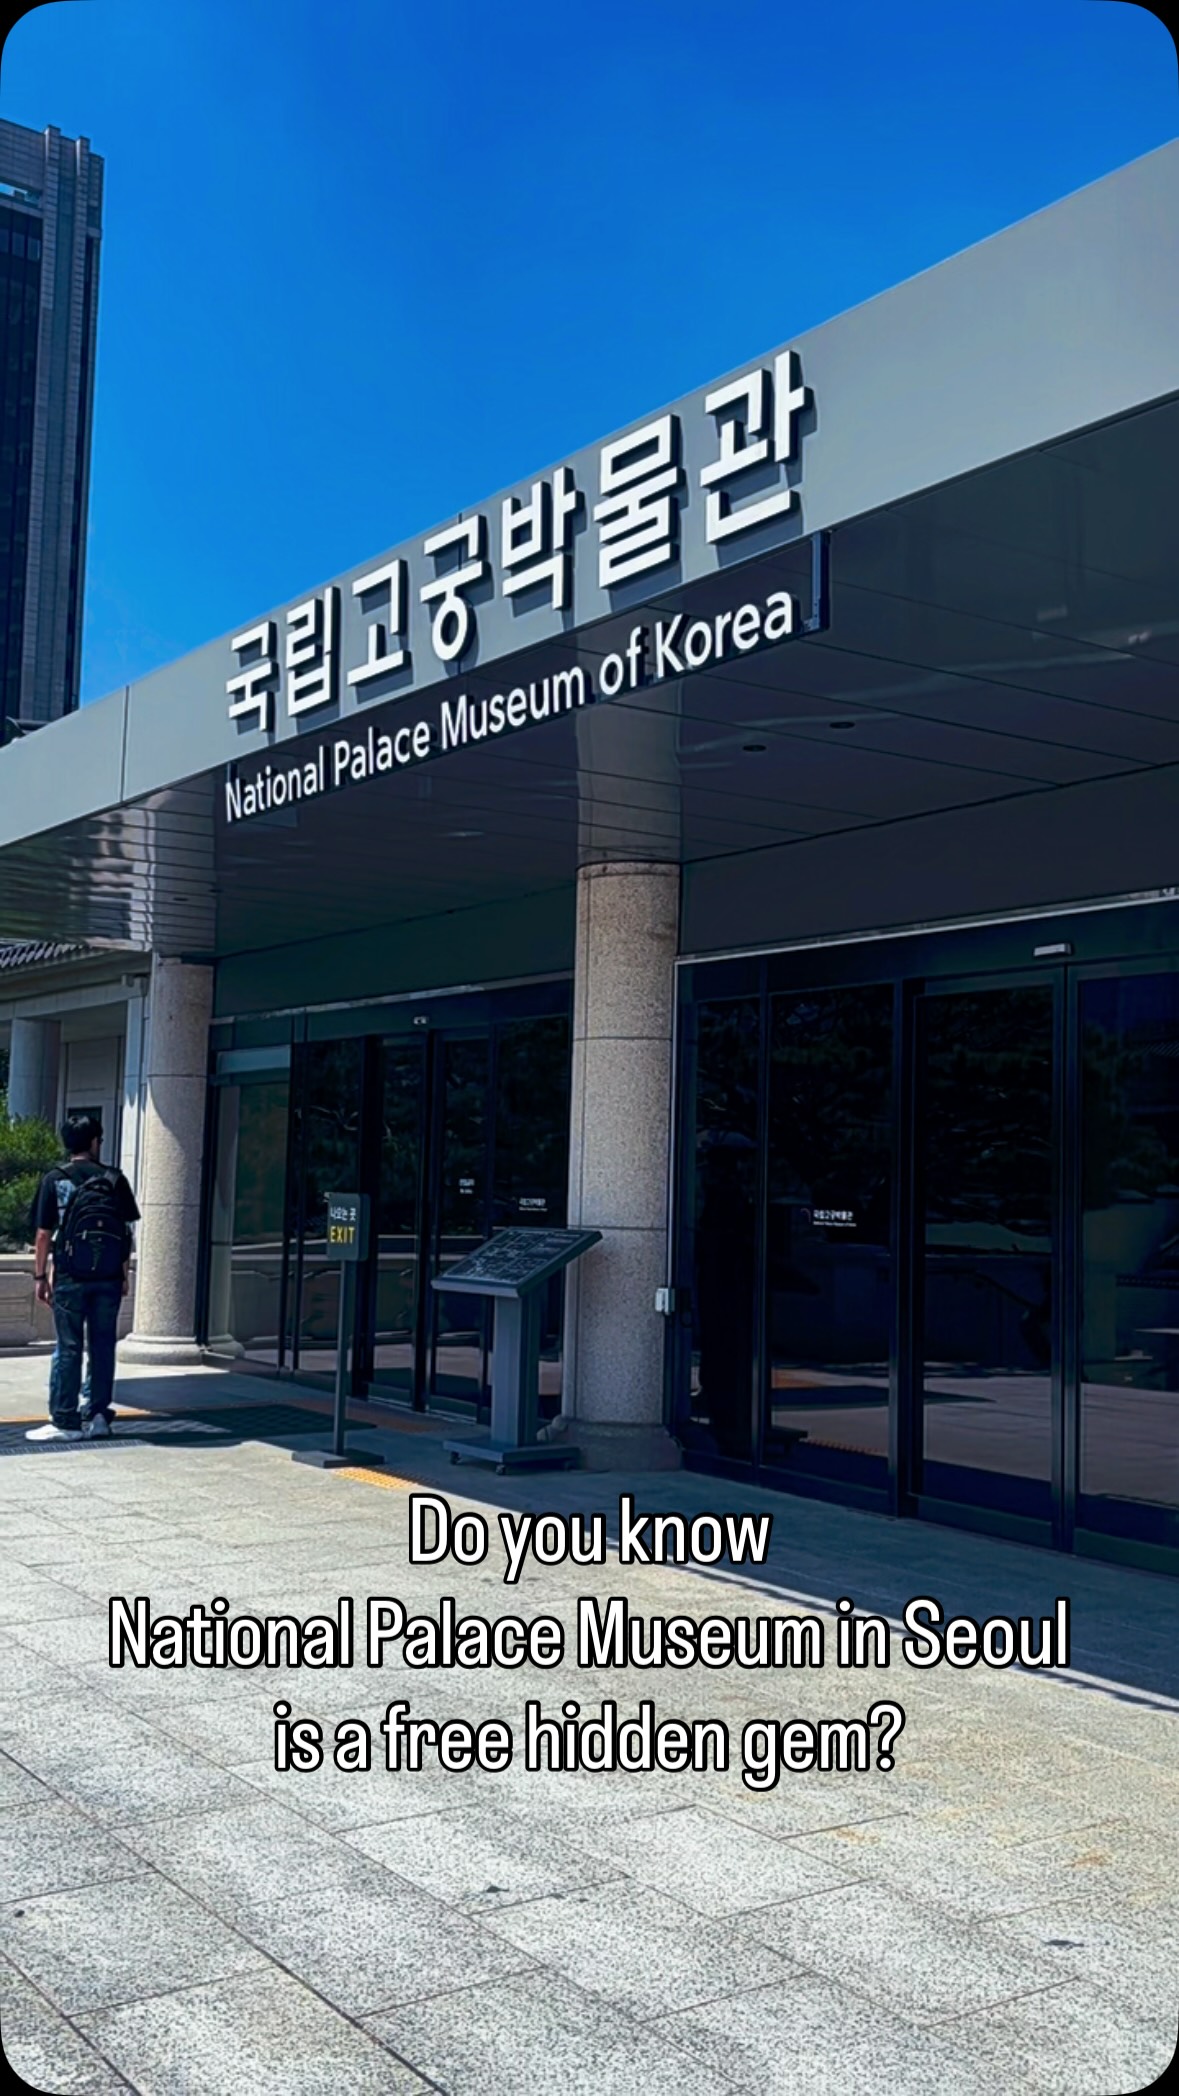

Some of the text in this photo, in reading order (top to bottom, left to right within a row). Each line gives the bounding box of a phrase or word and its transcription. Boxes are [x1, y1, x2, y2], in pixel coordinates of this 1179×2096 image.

[225, 349, 806, 732] 국립고궁박물관
[224, 590, 794, 823] National Palace Museum of Korea
[330, 1225, 356, 1244] EXIT
